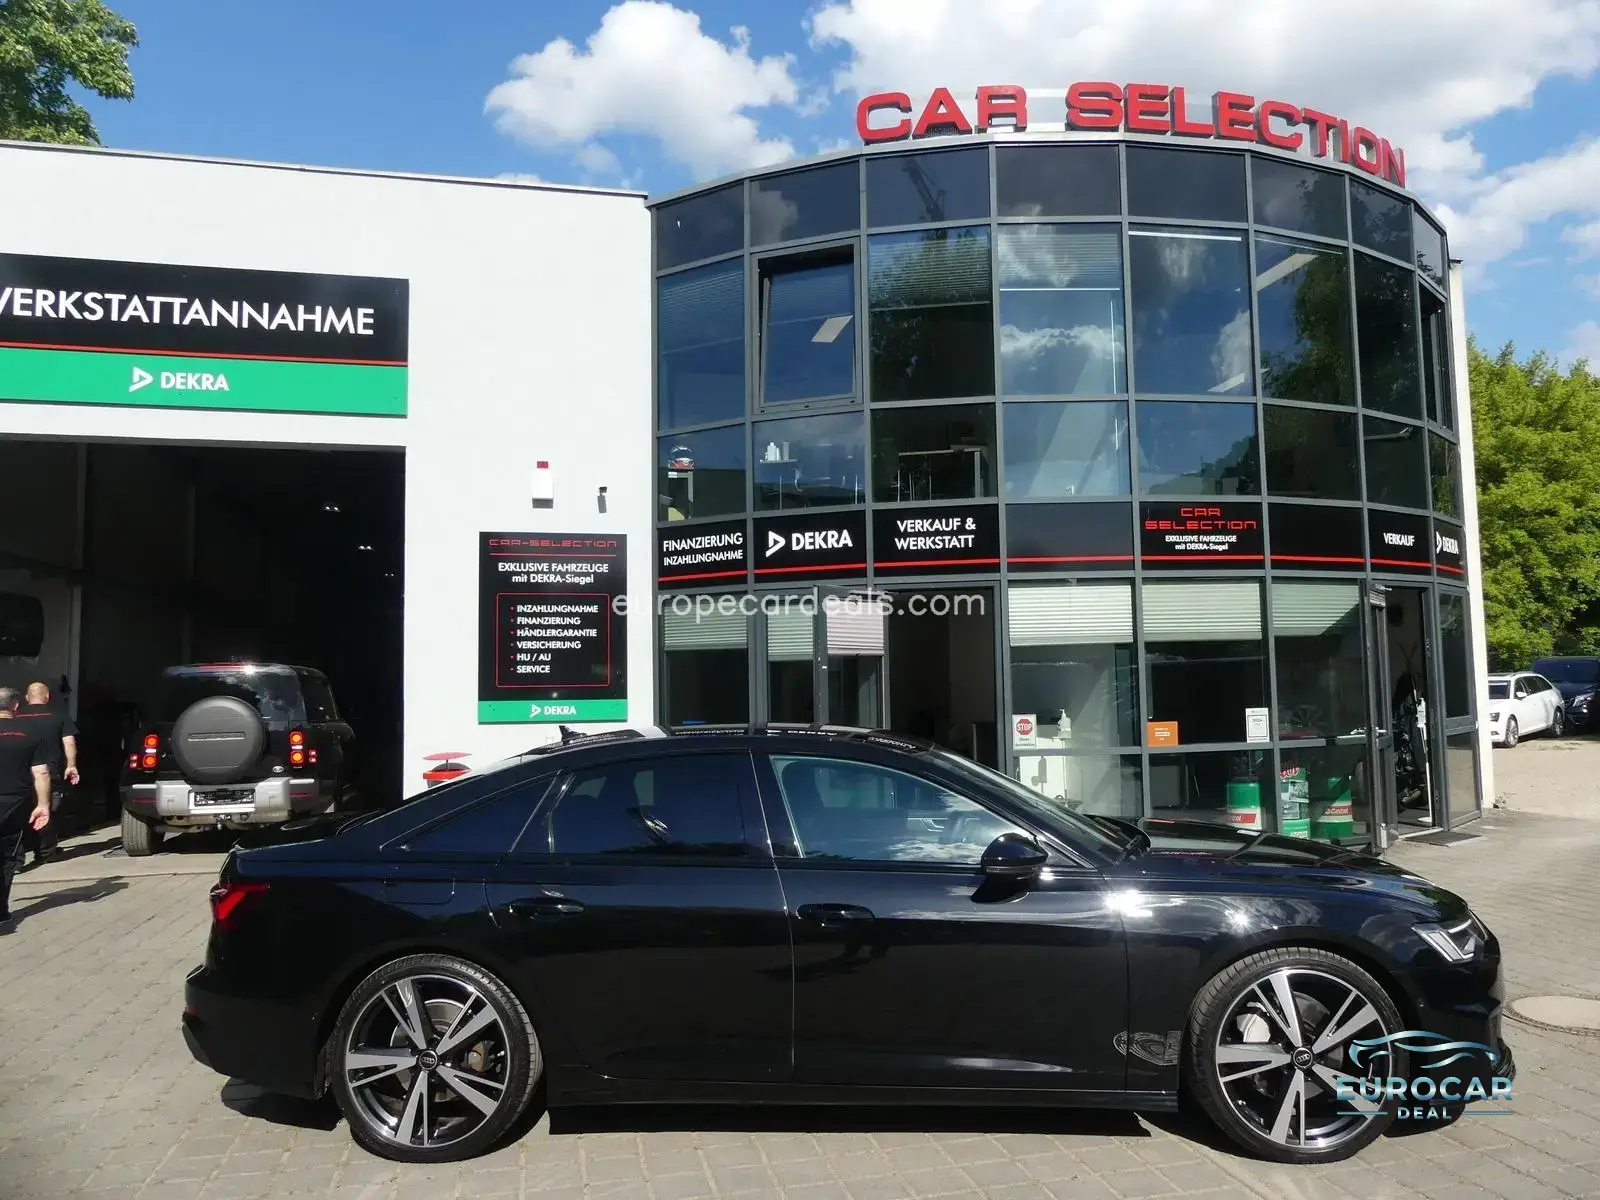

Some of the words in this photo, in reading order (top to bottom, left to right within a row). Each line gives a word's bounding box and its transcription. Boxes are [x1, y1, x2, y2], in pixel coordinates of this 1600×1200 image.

[856, 84, 1028, 145] CAR
[1066, 81, 1406, 189] SELECTION
[160, 371, 230, 392] DEKRA
[1180, 508, 1220, 517] CAR
[897, 518, 961, 533] VERKAUF
[965, 517, 976, 530] &
[1144, 521, 1257, 530] SELECTION
[489, 539, 617, 548] CAR-SELECTION
[663, 532, 743, 552] FINANZIERUNG
[791, 529, 853, 551] DEKRA
[895, 535, 975, 550] WERKSTATT
[1200, 535, 1237, 543] FAHRZEUGE
[1383, 532, 1415, 547] VERKAUF
[1442, 536, 1459, 554] DEKRA
[663, 549, 743, 566] INZAHLUNGNAHME
[498, 562, 549, 572] EXKLUSIVE
[551, 563, 609, 573] FAHRZEUGE
[512, 574, 528, 583] mit
[530, 574, 594, 585] DEKRA-Siegel
[516, 604, 599, 613] INZAHLUNGNAHME
[516, 616, 581, 626] FINANZIERUNG
[516, 628, 598, 637] HÄNDLERGARANTIE
[516, 640, 582, 650] VERSICHERUNG
[516, 653, 531, 661] HU
[538, 653, 551, 661] AU
[516, 665, 550, 673] SERVICE
[544, 706, 577, 715] DEKRA
